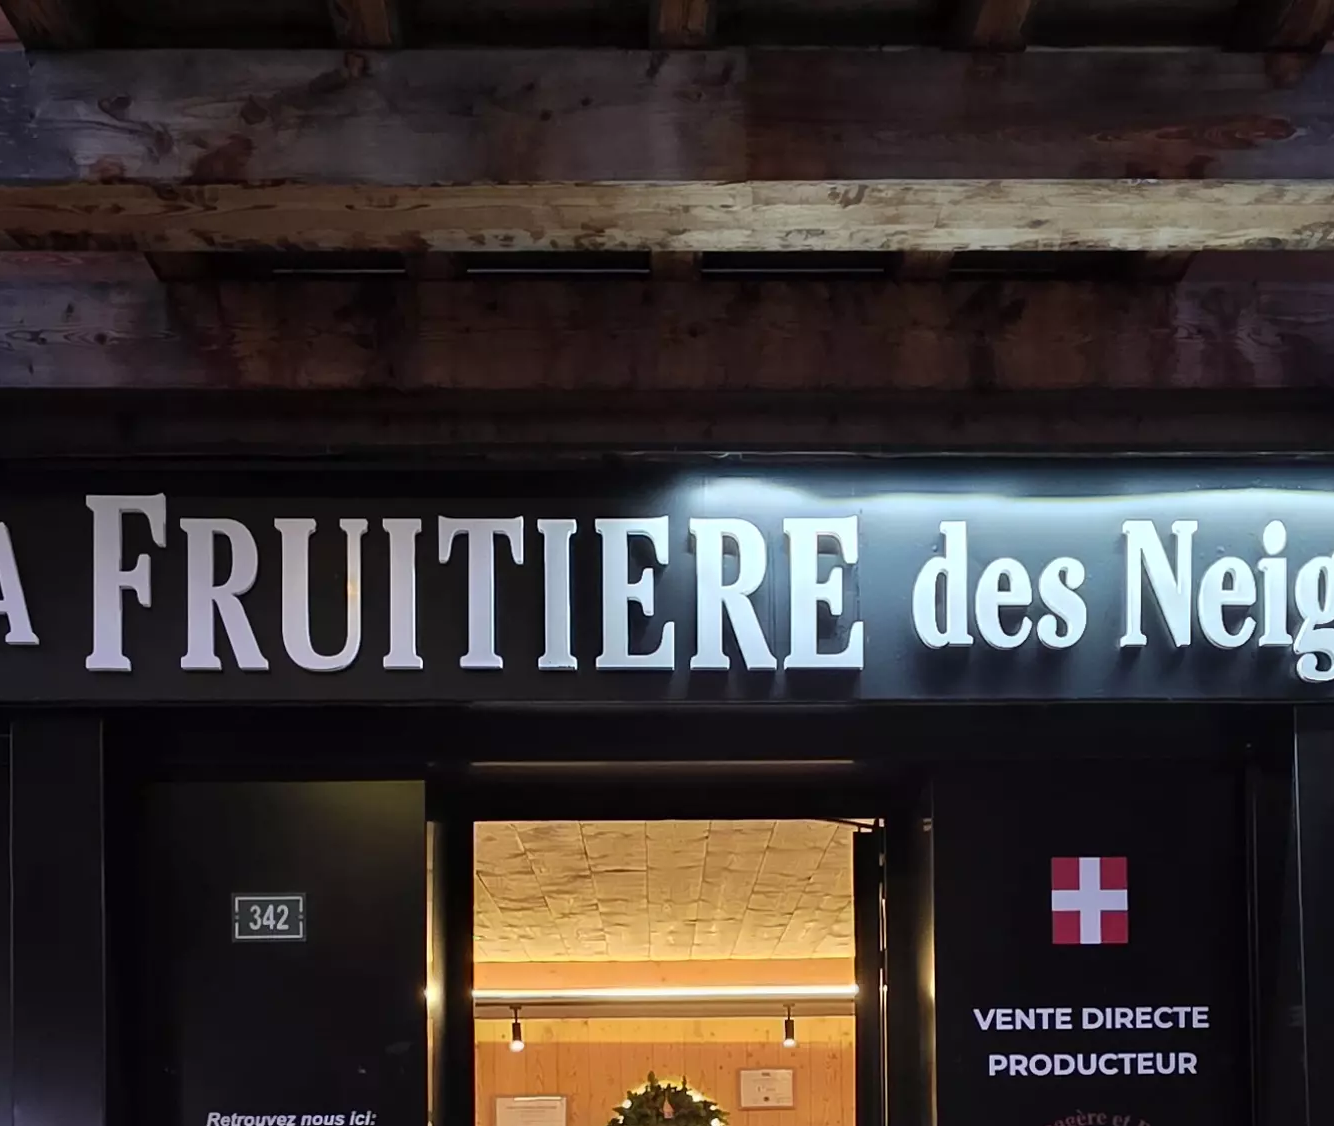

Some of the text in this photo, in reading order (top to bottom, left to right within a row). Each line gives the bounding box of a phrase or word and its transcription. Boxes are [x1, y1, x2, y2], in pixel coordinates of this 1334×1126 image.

[85, 493, 865, 673] FRUITIERE
[912, 520, 1088, 649] des
[249, 904, 290, 931] 342
[973, 1006, 1210, 1031] VENTE DIRECTE
[988, 1052, 1198, 1076] PRODUCTEUR
[206, 1111, 377, 1126] Retrouvez nous ici:
